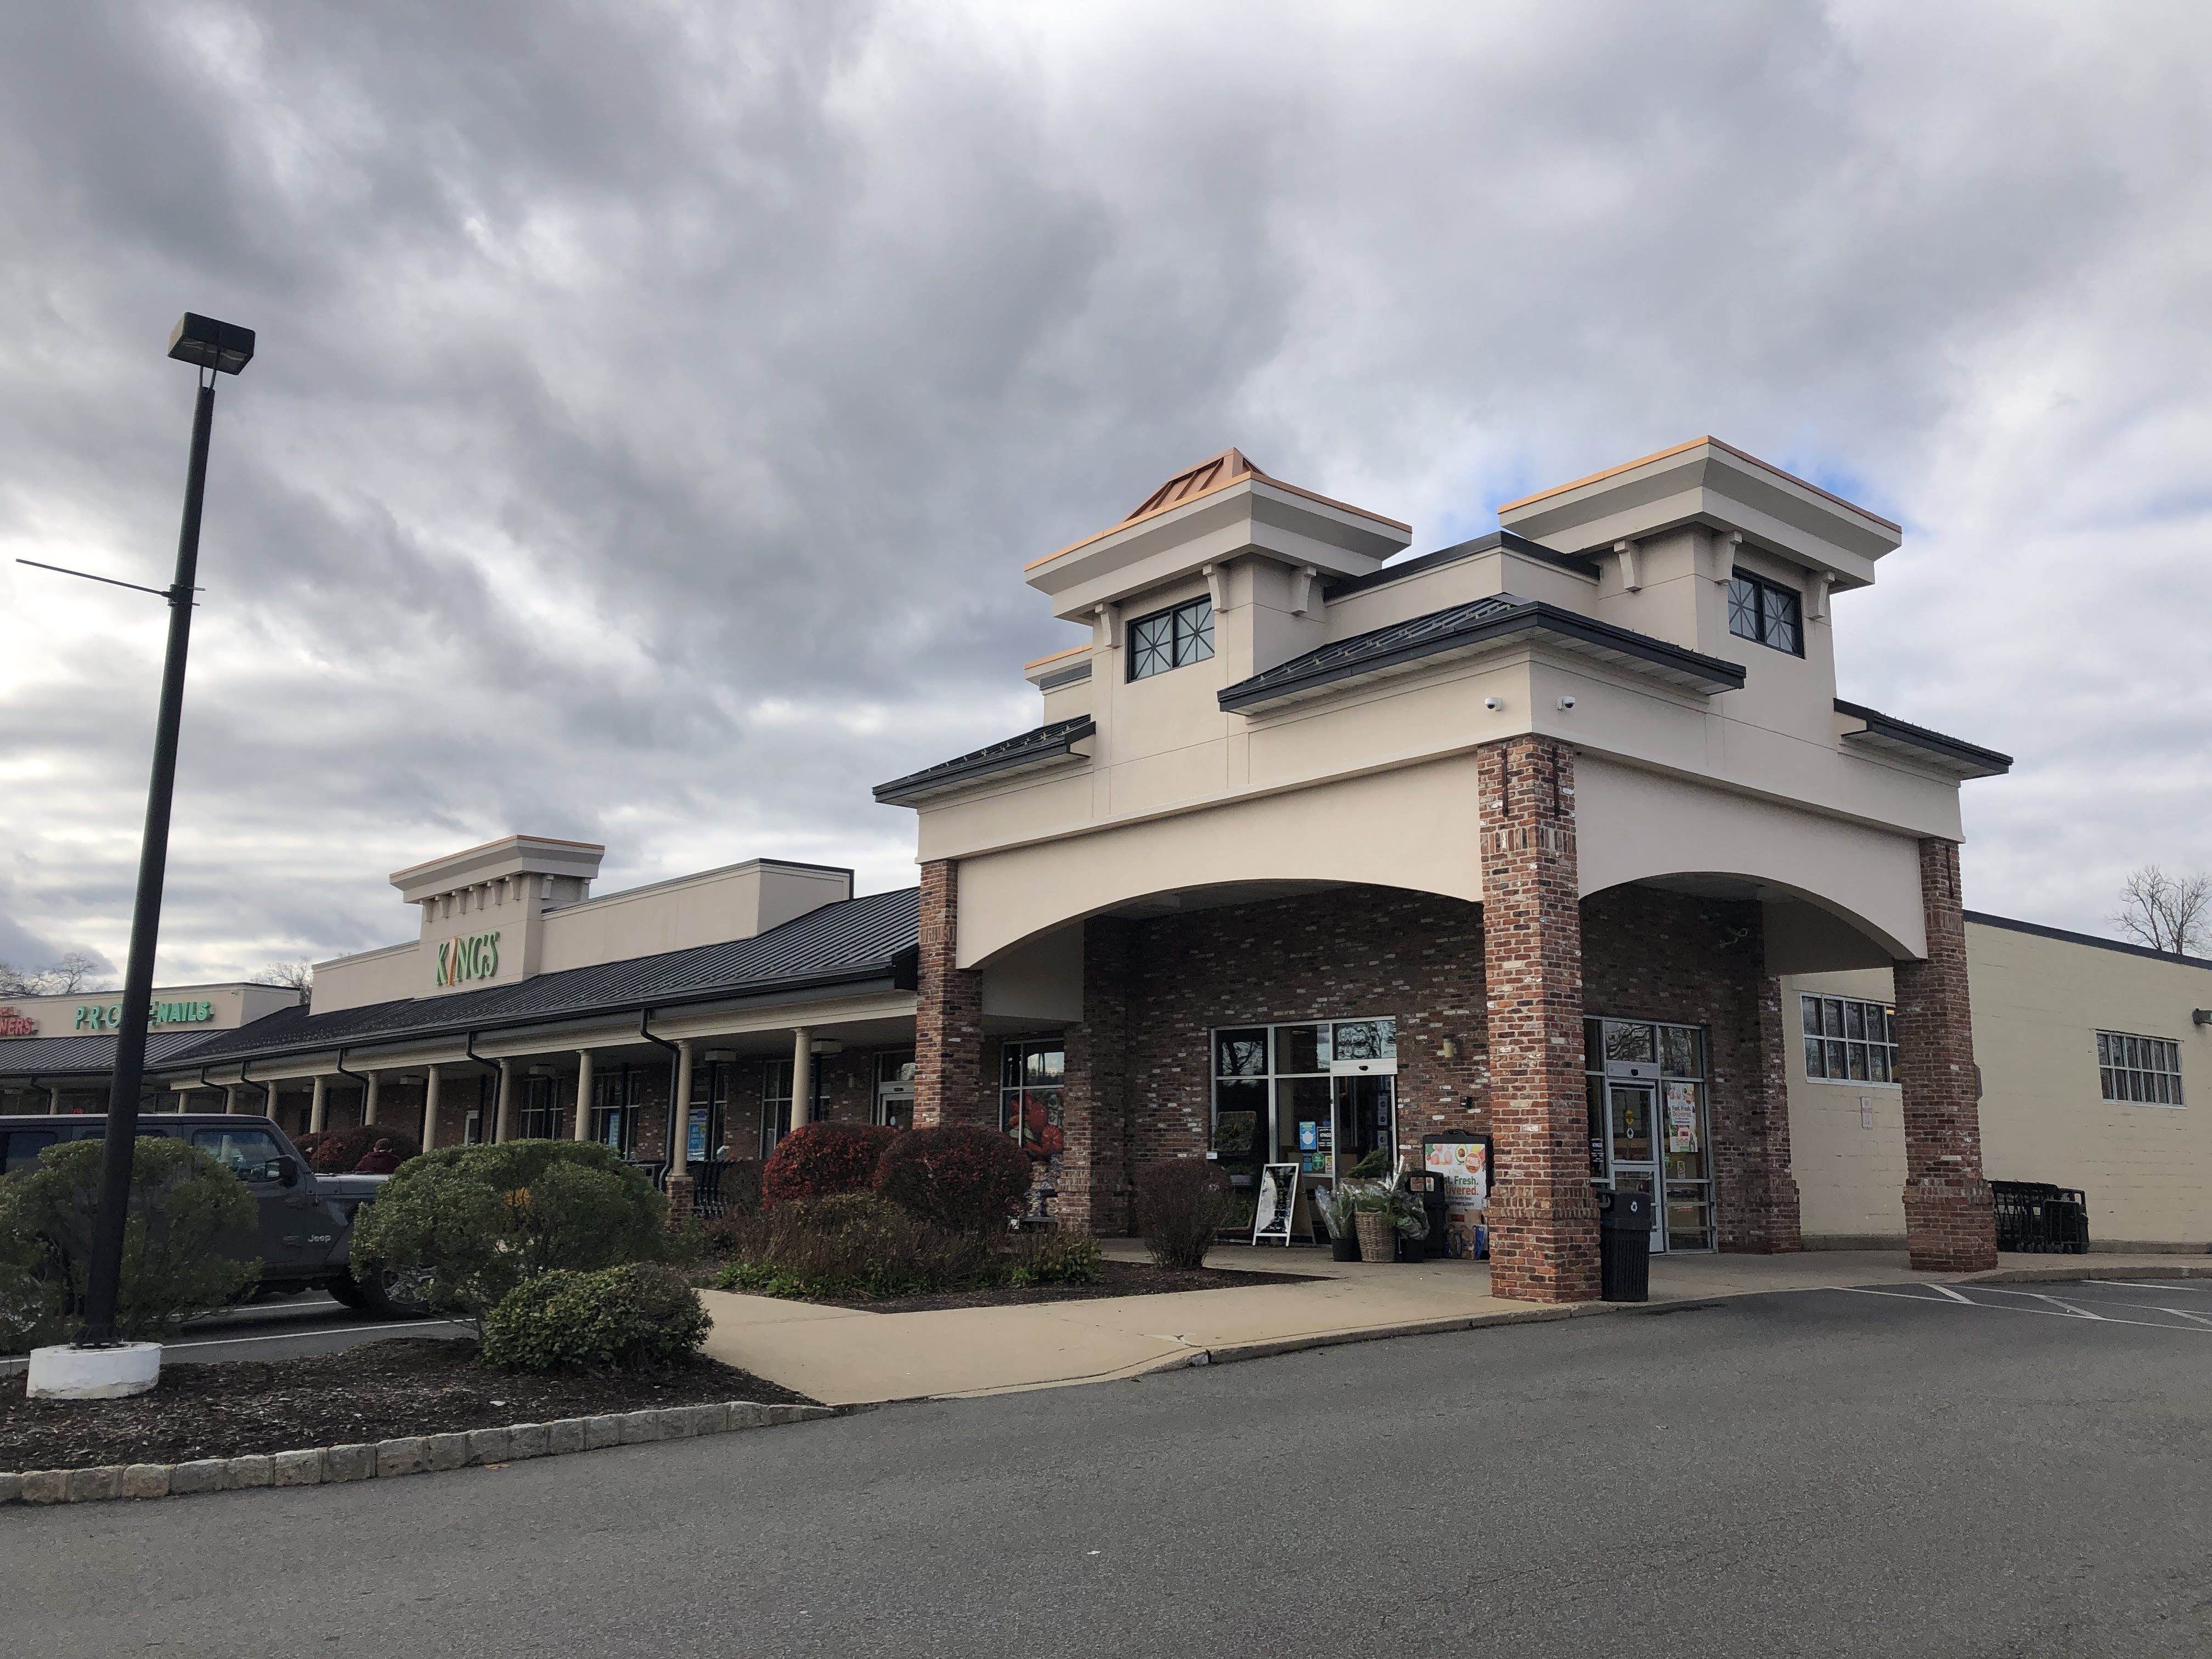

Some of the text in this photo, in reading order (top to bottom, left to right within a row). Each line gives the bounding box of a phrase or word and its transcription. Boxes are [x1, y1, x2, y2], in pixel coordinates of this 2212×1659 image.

[437, 931, 500, 986] KINGS
[157, 1001, 212, 1023] NAILS
[0, 1017, 32, 1035] NERS
[1445, 1186, 1479, 1195] livered.
[307, 1234, 331, 1243] Jeep
